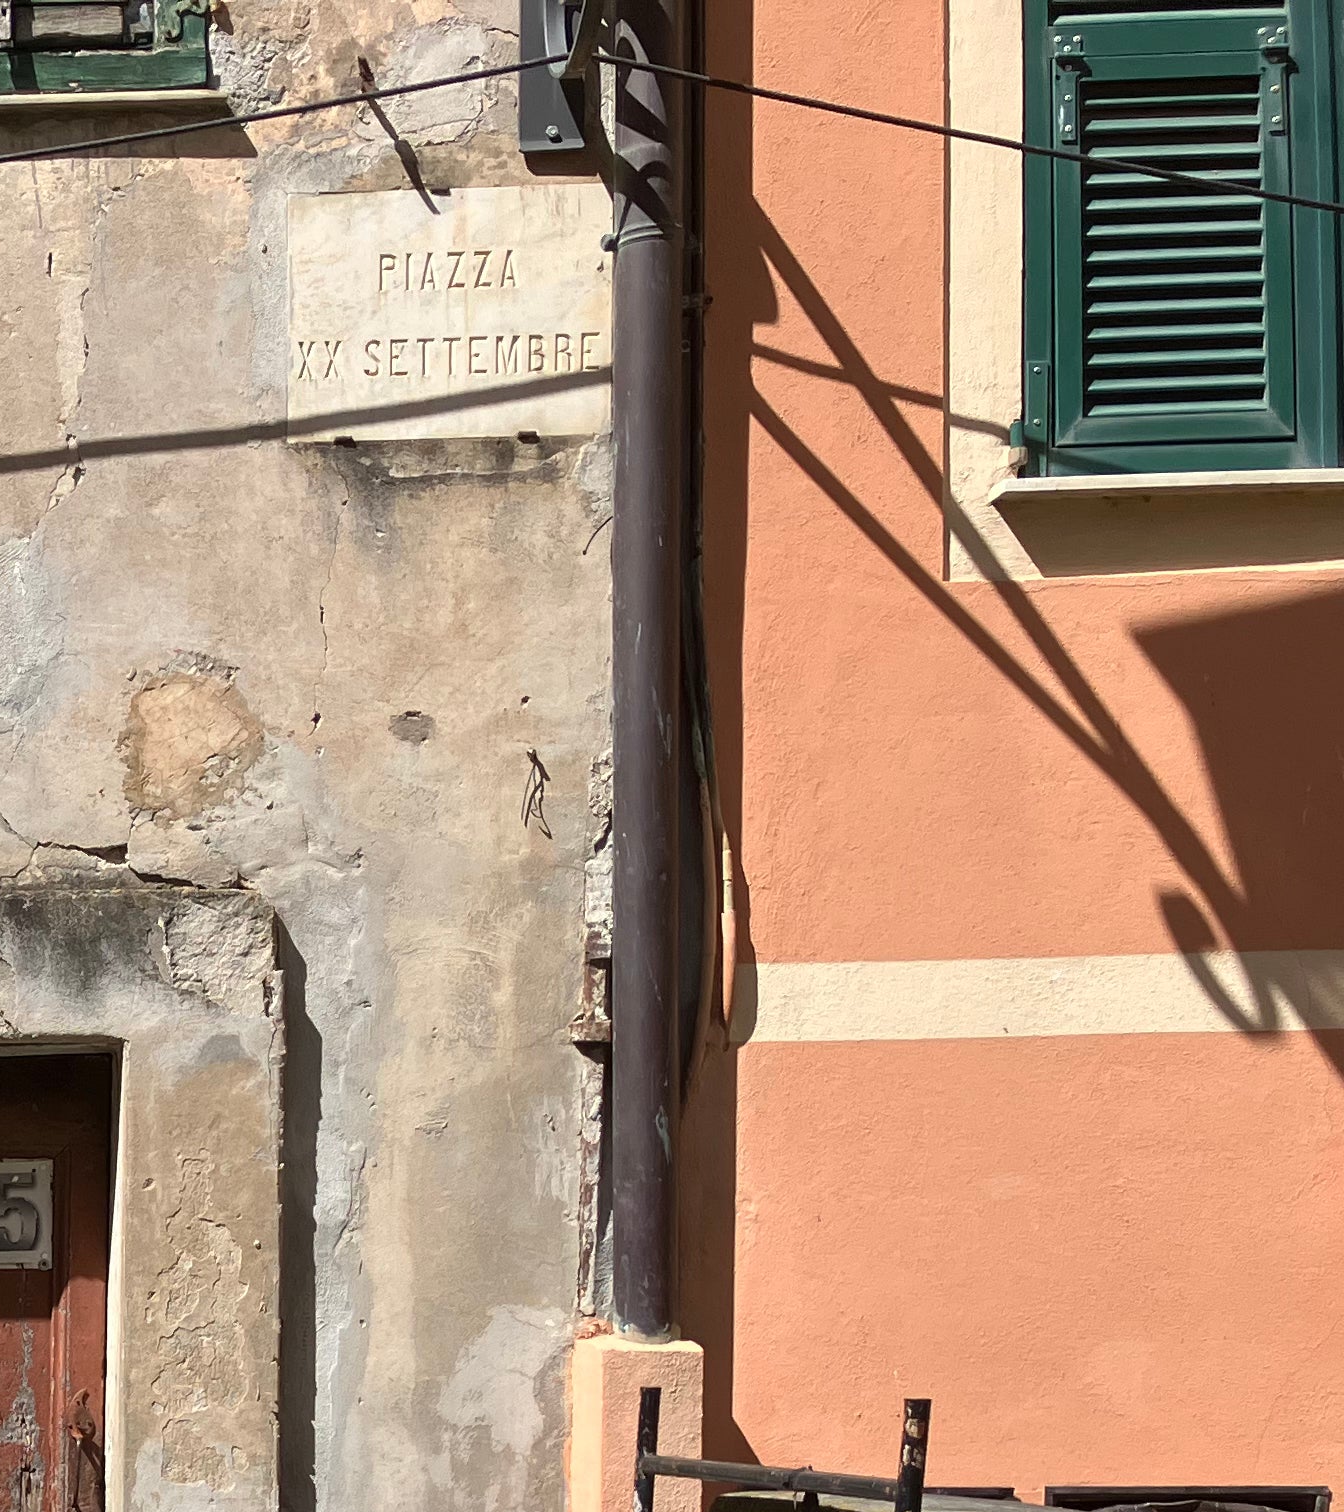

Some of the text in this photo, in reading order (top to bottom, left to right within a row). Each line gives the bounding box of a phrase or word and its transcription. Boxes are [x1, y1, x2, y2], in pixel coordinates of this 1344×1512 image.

[378, 249, 519, 292] PIAZZA
[297, 331, 601, 380] XX SETTEMBRE
